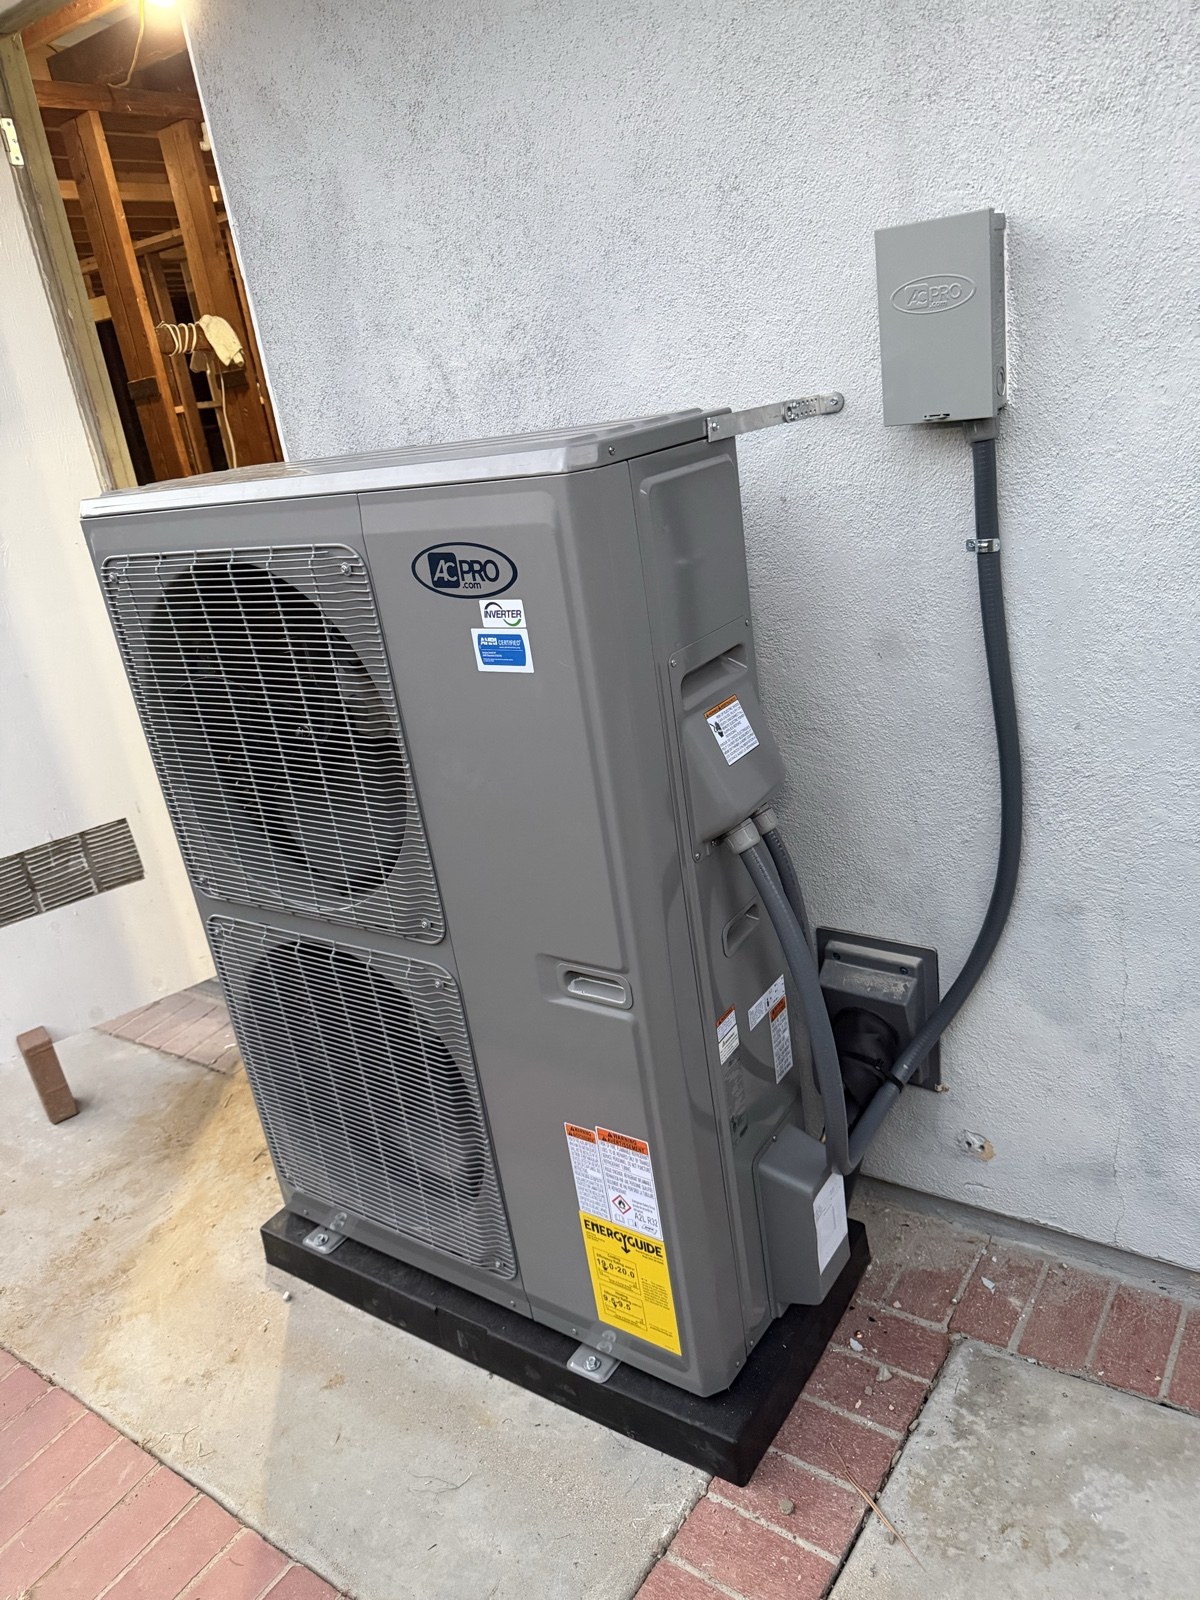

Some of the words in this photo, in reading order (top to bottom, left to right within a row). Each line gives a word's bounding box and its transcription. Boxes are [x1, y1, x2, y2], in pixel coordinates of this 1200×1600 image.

[484, 609, 522, 619] INVERTER
[634, 1212, 647, 1223] A2L
[647, 1216, 658, 1227] R32
[583, 1219, 663, 1258] ENERGYGUIDE
